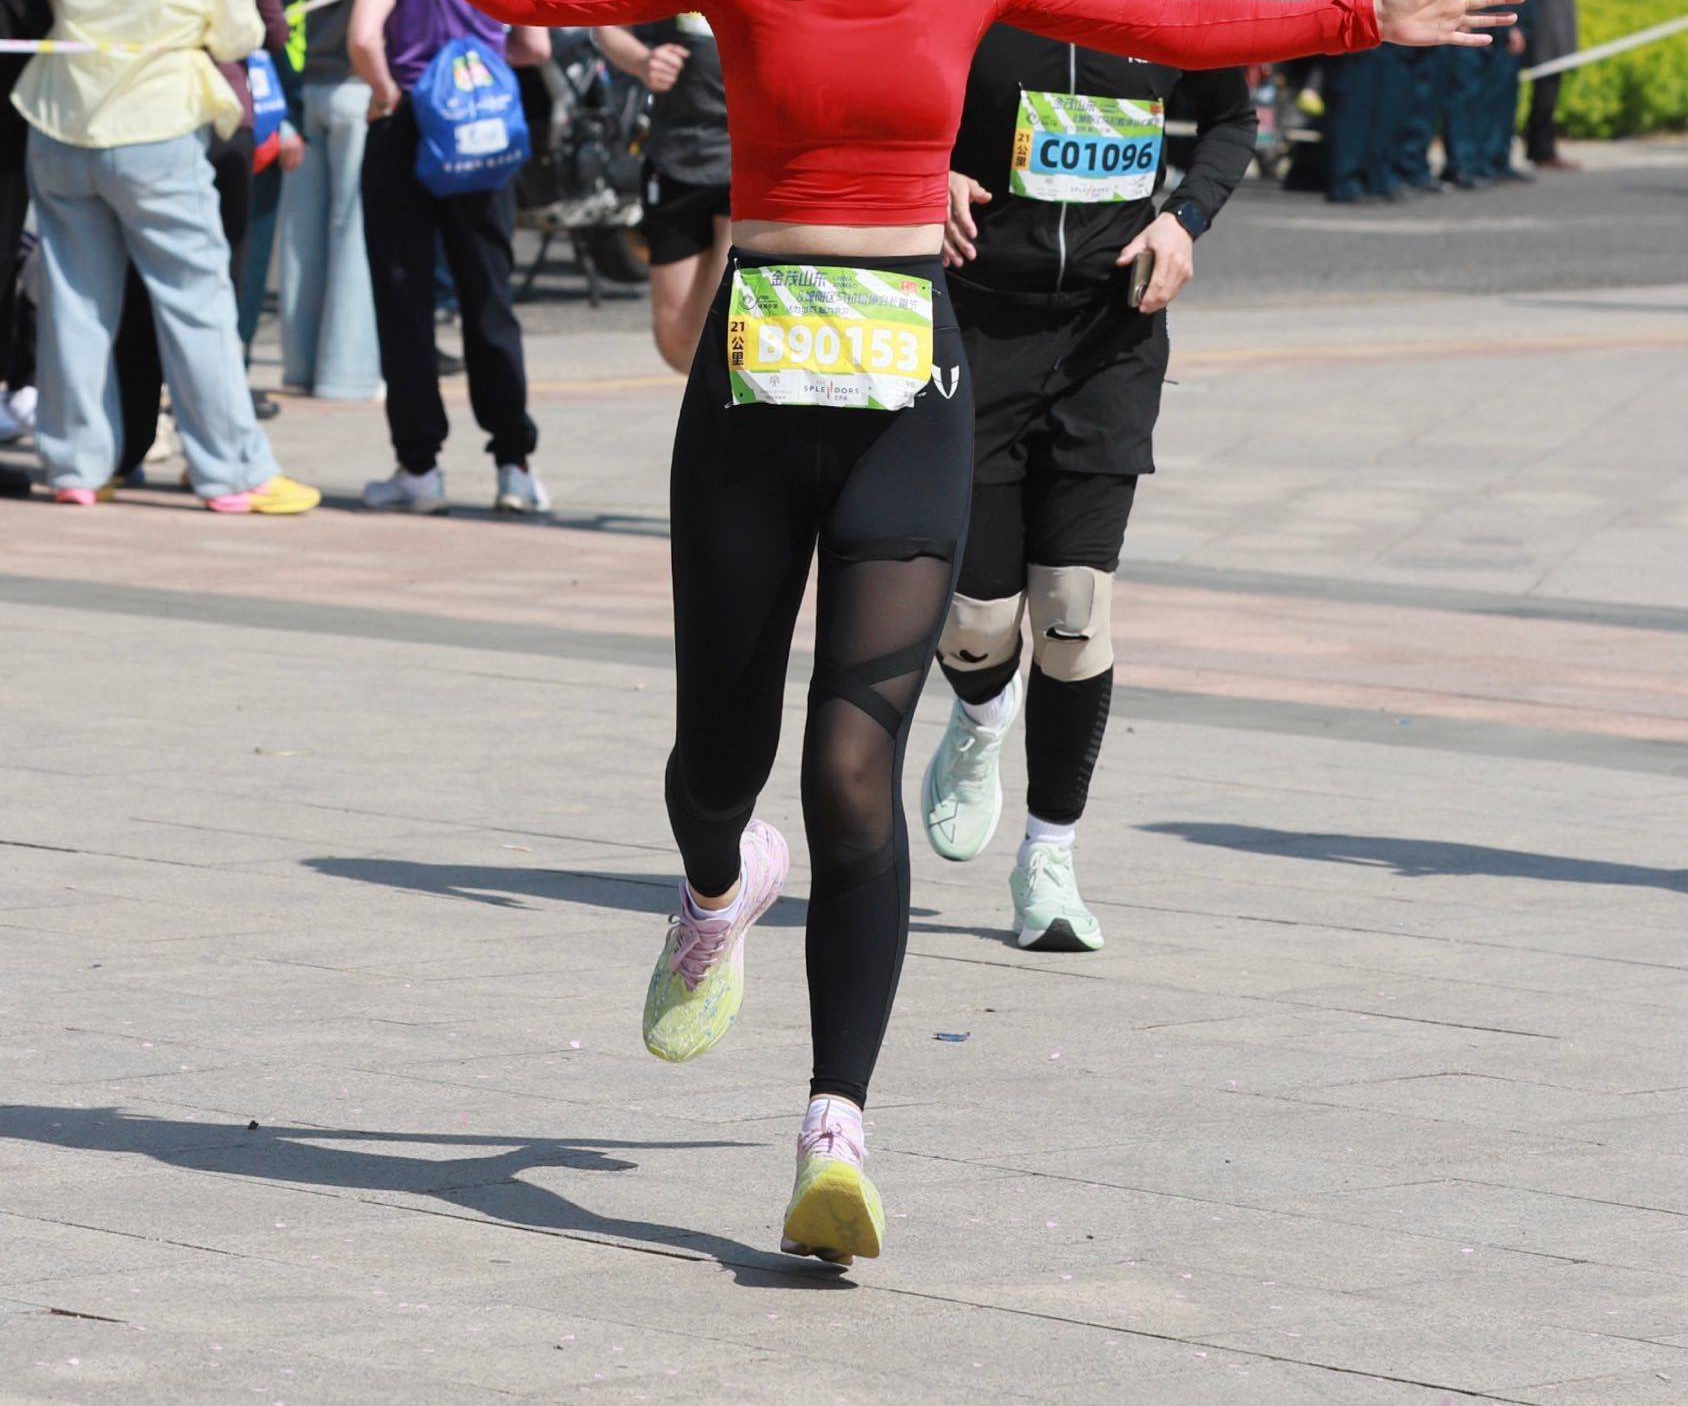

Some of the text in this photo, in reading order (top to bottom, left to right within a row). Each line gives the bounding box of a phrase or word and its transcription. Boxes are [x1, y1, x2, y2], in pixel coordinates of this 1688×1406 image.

[1015, 133, 1030, 167] 21 公里
[1040, 139, 1153, 172] C01096
[771, 270, 827, 287] 金茂山东
[730, 321, 745, 366] 21 公里
[758, 324, 919, 372] B90153
